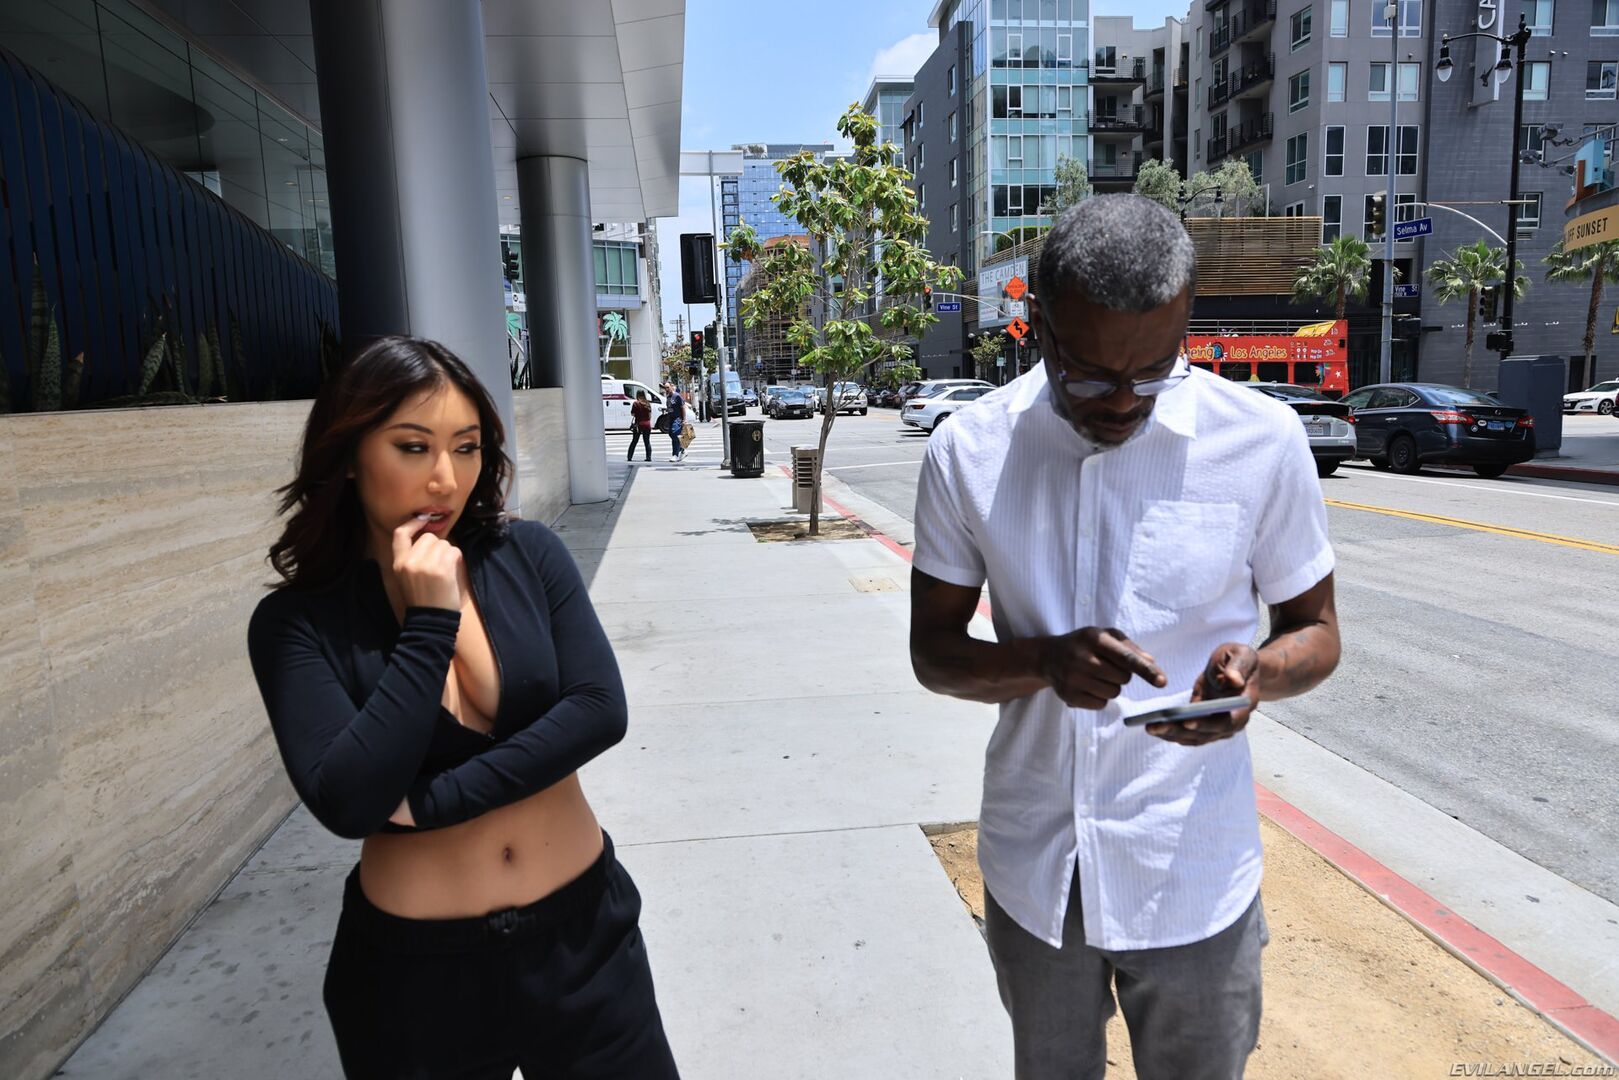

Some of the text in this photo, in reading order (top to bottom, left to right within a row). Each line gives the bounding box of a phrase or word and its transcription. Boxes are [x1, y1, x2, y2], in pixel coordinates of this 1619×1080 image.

[1396, 223, 1428, 236] Selma Av
[1576, 217, 1608, 239] SUNSET
[981, 270, 994, 285] THE
[940, 303, 959, 311] Vine St
[1230, 345, 1248, 358] Los
[1250, 346, 1287, 360] Angeles
